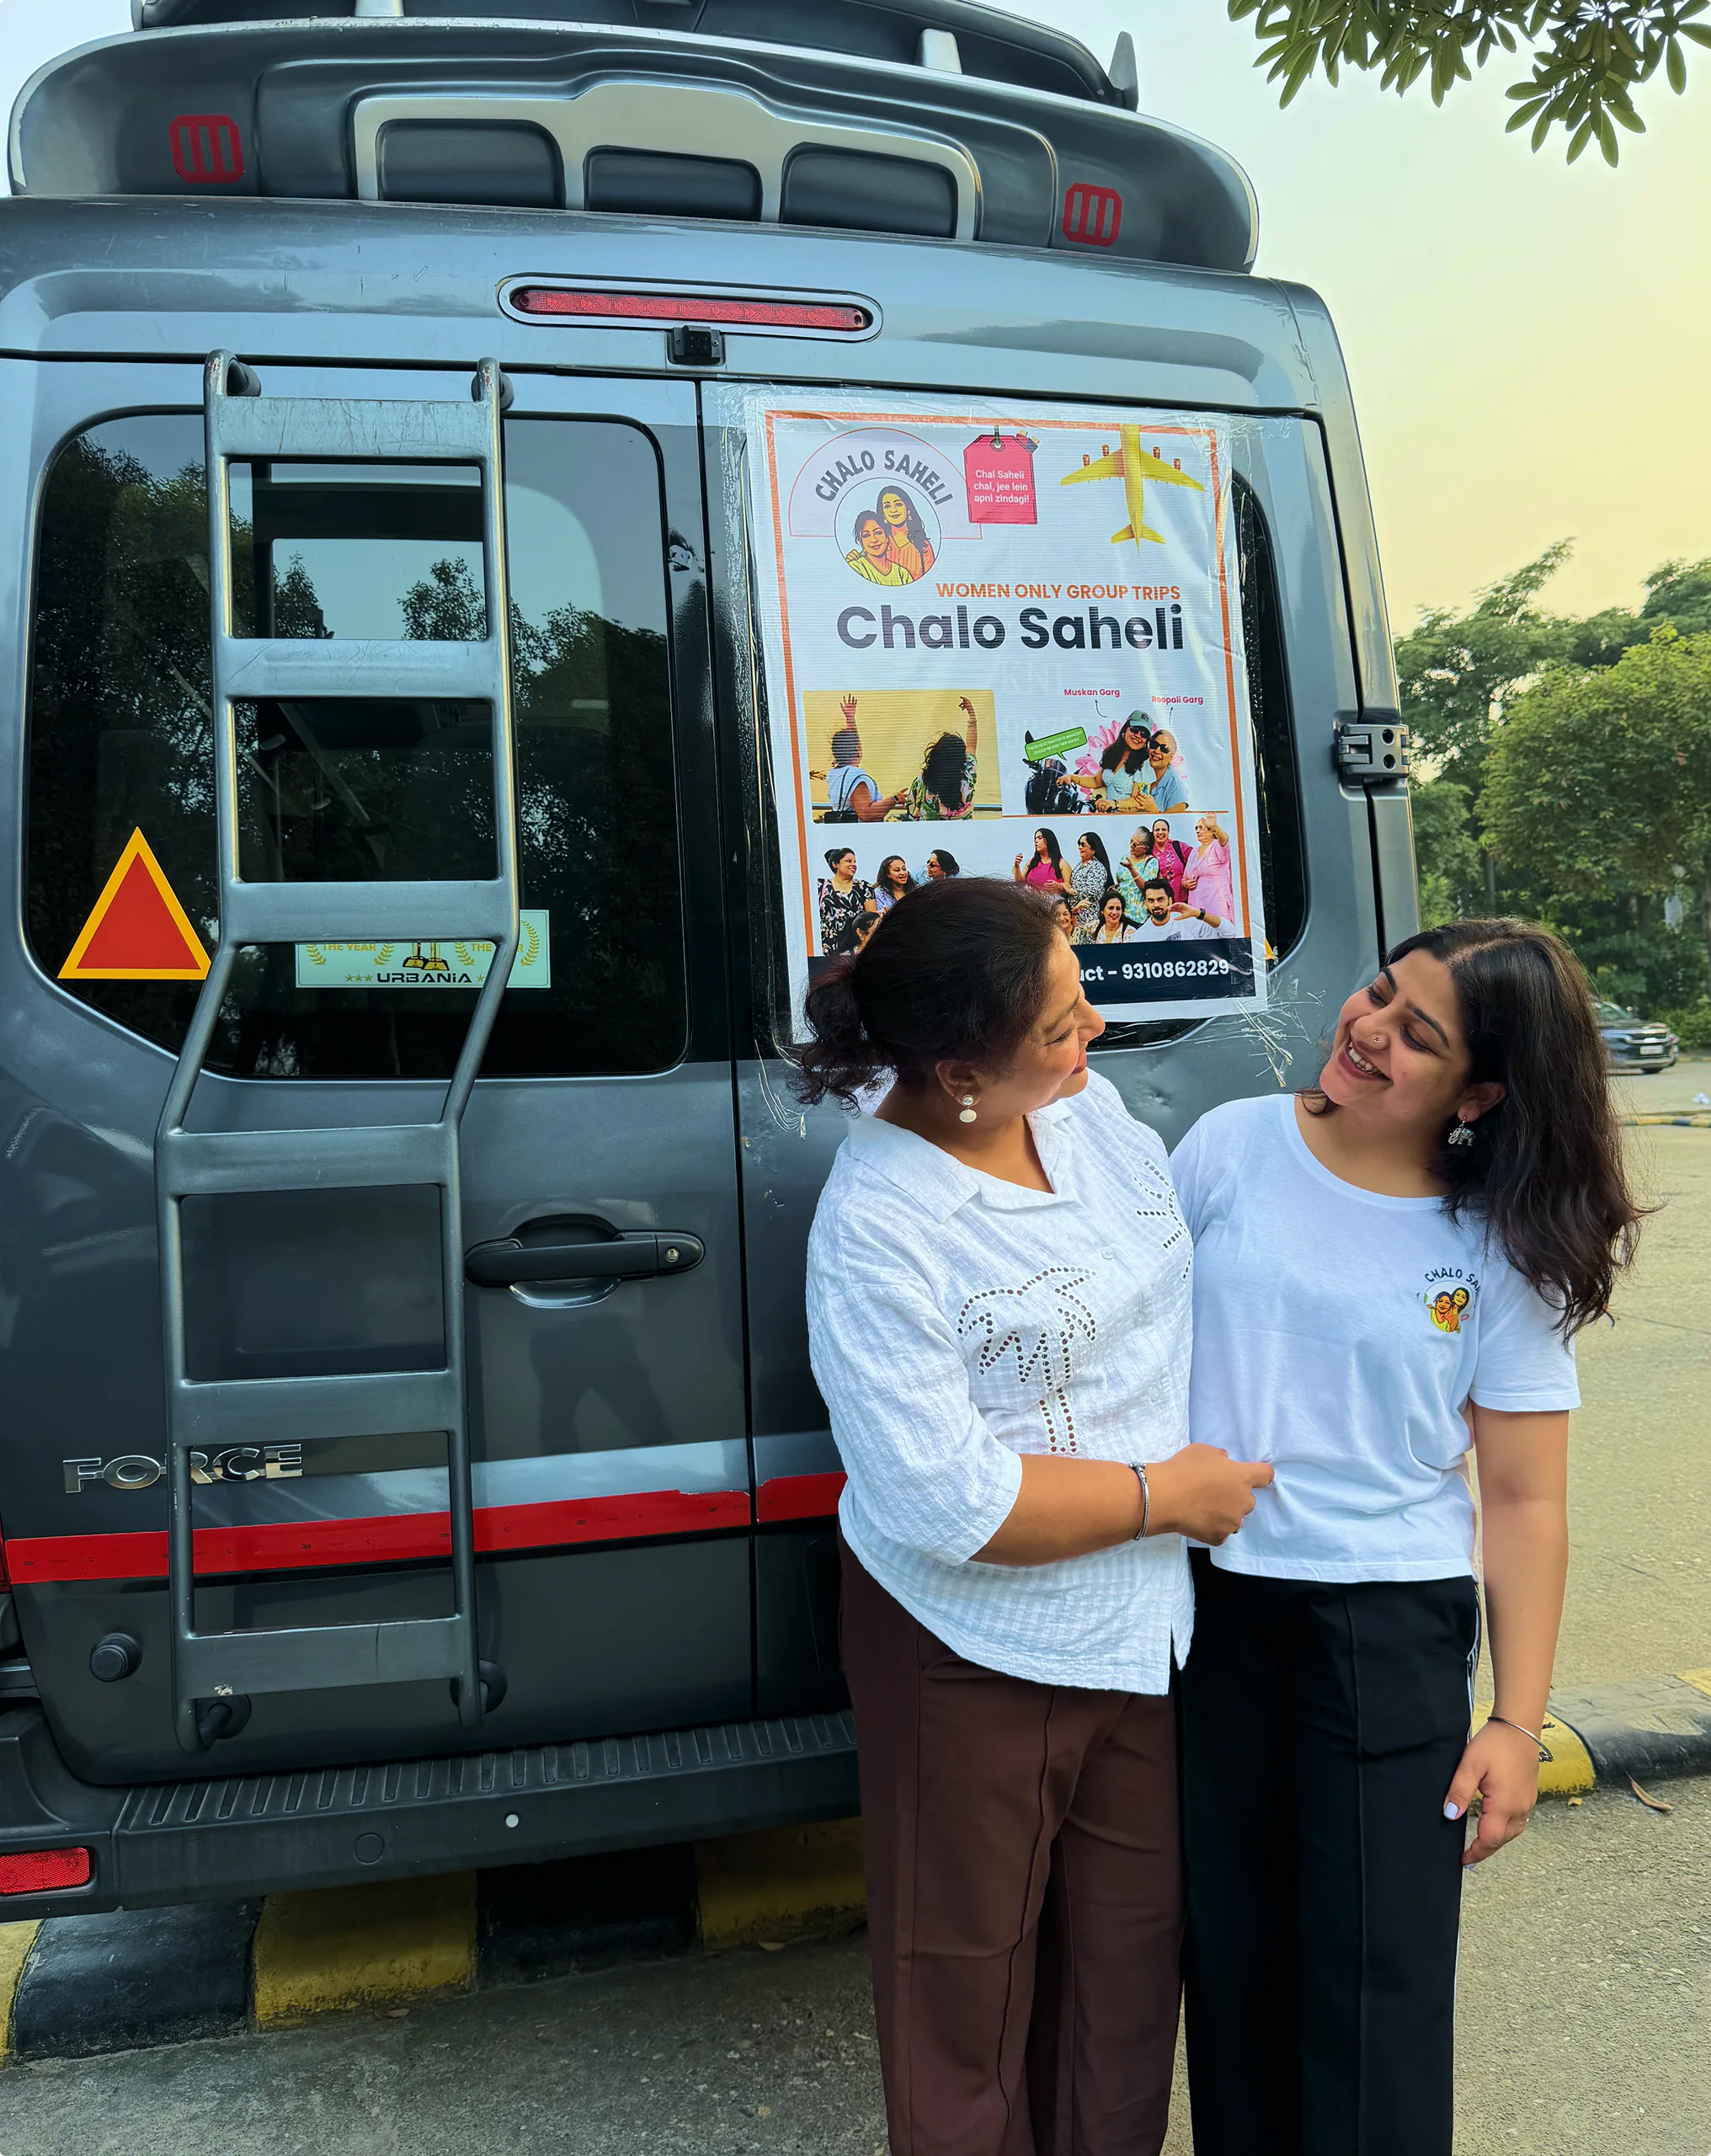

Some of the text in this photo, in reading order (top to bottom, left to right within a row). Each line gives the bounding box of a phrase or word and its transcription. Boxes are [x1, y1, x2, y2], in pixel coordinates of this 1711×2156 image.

[815, 450, 953, 505] CHALO SAHELI
[975, 469, 1025, 479] Chal Saheli
[973, 482, 1028, 493] chal, jee lein
[974, 494, 1030, 505] apni zindagi!
[936, 583, 1181, 600] WOMEN ONLY GROUP TRIPS
[837, 604, 1184, 650] Chalo Saheli
[1063, 688, 1121, 698] Muskan Garg
[1151, 696, 1204, 706] Roopali Garg
[471, 942, 492, 952] THE
[1122, 958, 1229, 980] 9310862829
[1425, 1267, 1463, 1282] CHALO
